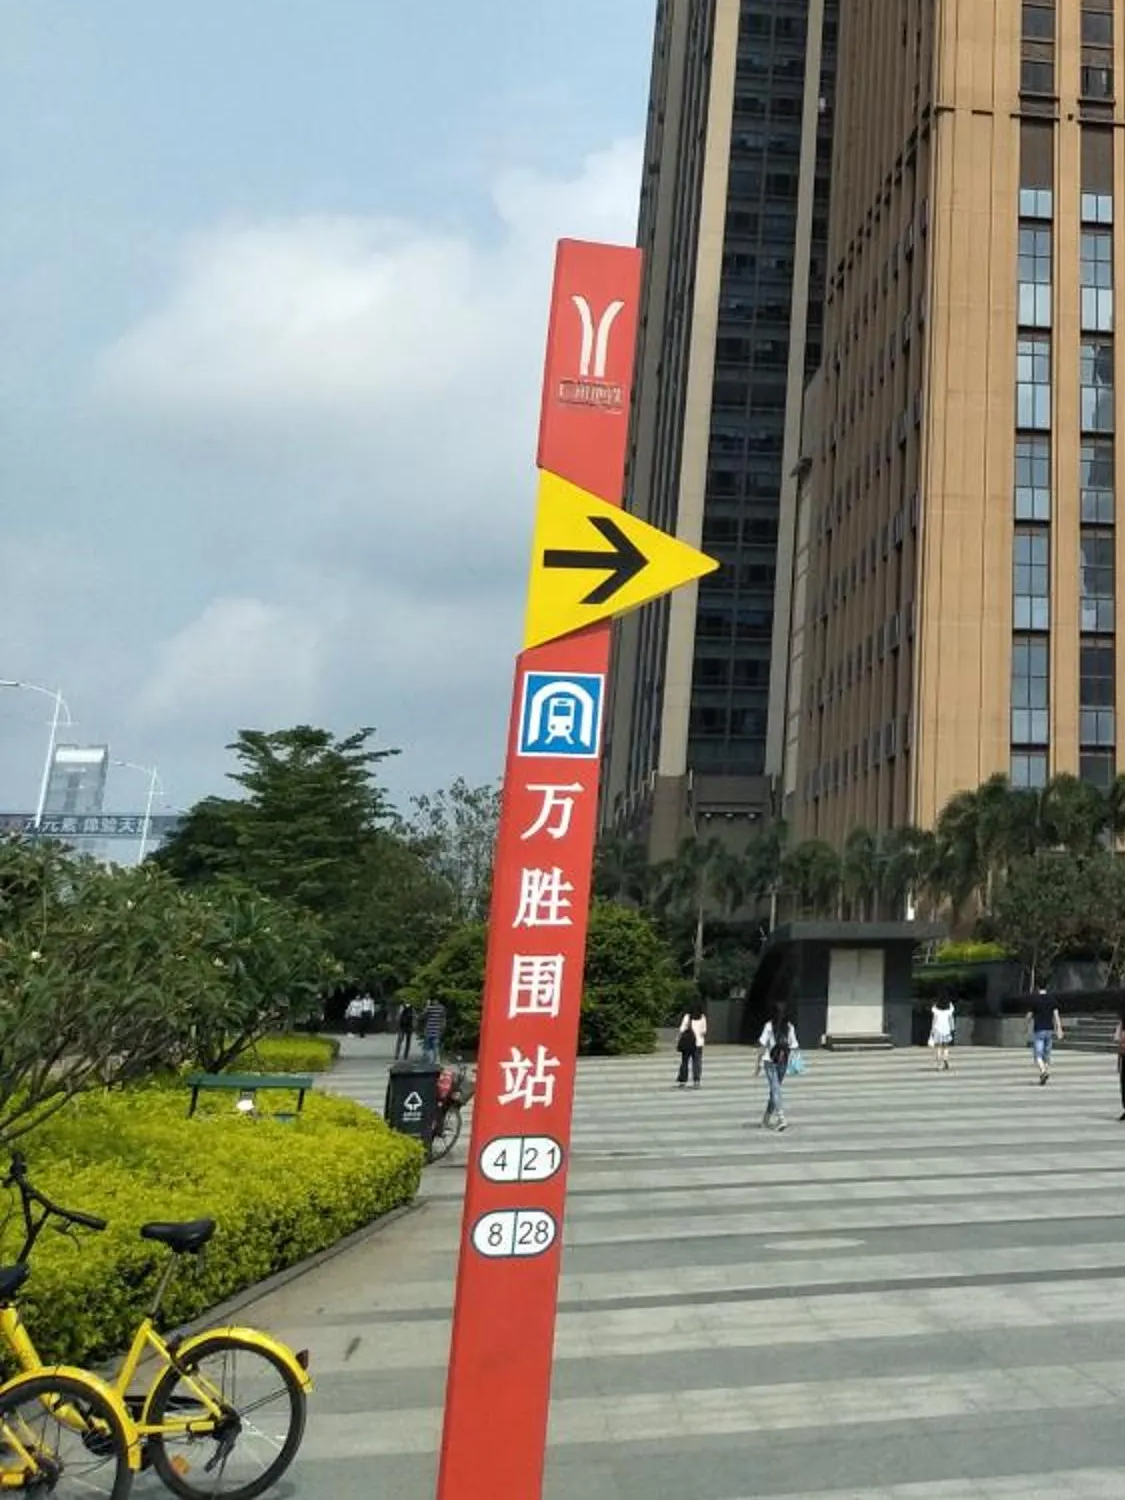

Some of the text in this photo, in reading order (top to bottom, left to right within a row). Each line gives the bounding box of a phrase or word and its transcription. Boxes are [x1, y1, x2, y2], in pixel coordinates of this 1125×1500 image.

[497, 781, 585, 1110] 万胜围站
[493, 1146, 557, 1172] 4 21
[487, 1219, 550, 1247] 8 28
